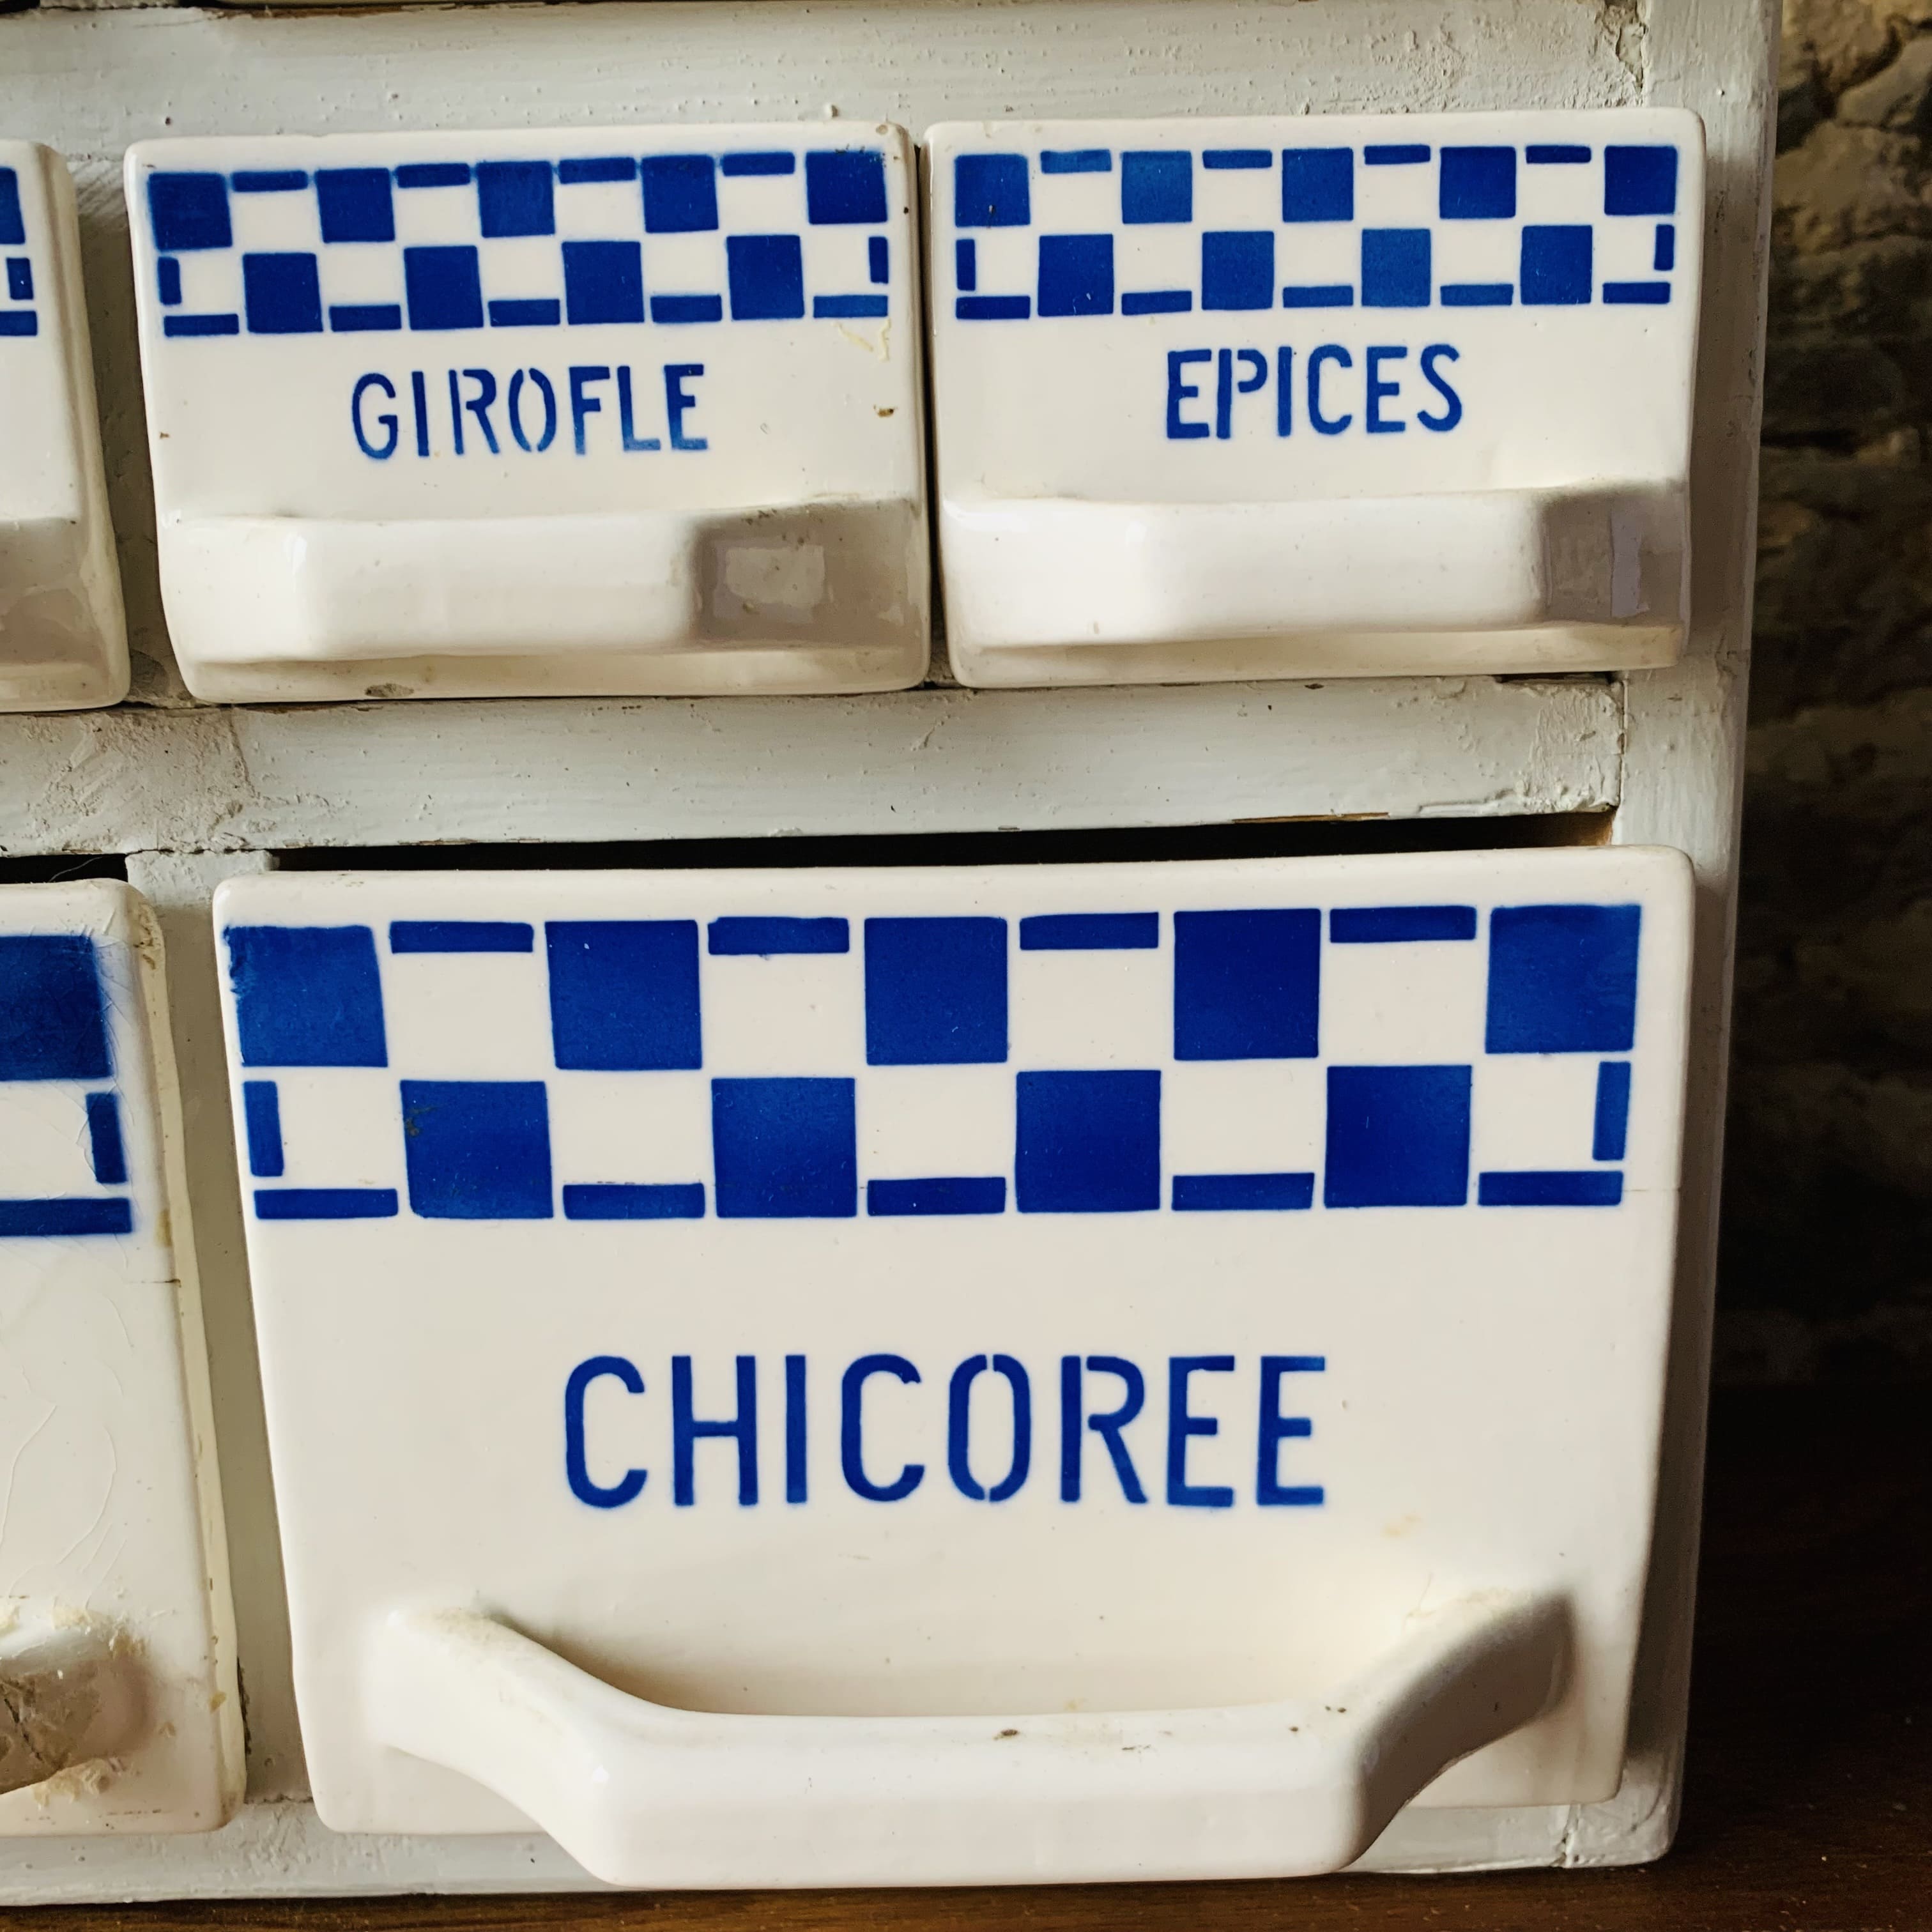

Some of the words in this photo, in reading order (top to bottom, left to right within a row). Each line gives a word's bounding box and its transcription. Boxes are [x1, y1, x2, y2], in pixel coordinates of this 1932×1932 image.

[351, 364, 708, 460] GIROFLE
[1166, 344, 1463, 440] EPICES
[564, 1353, 1326, 1508] CHICOREE
